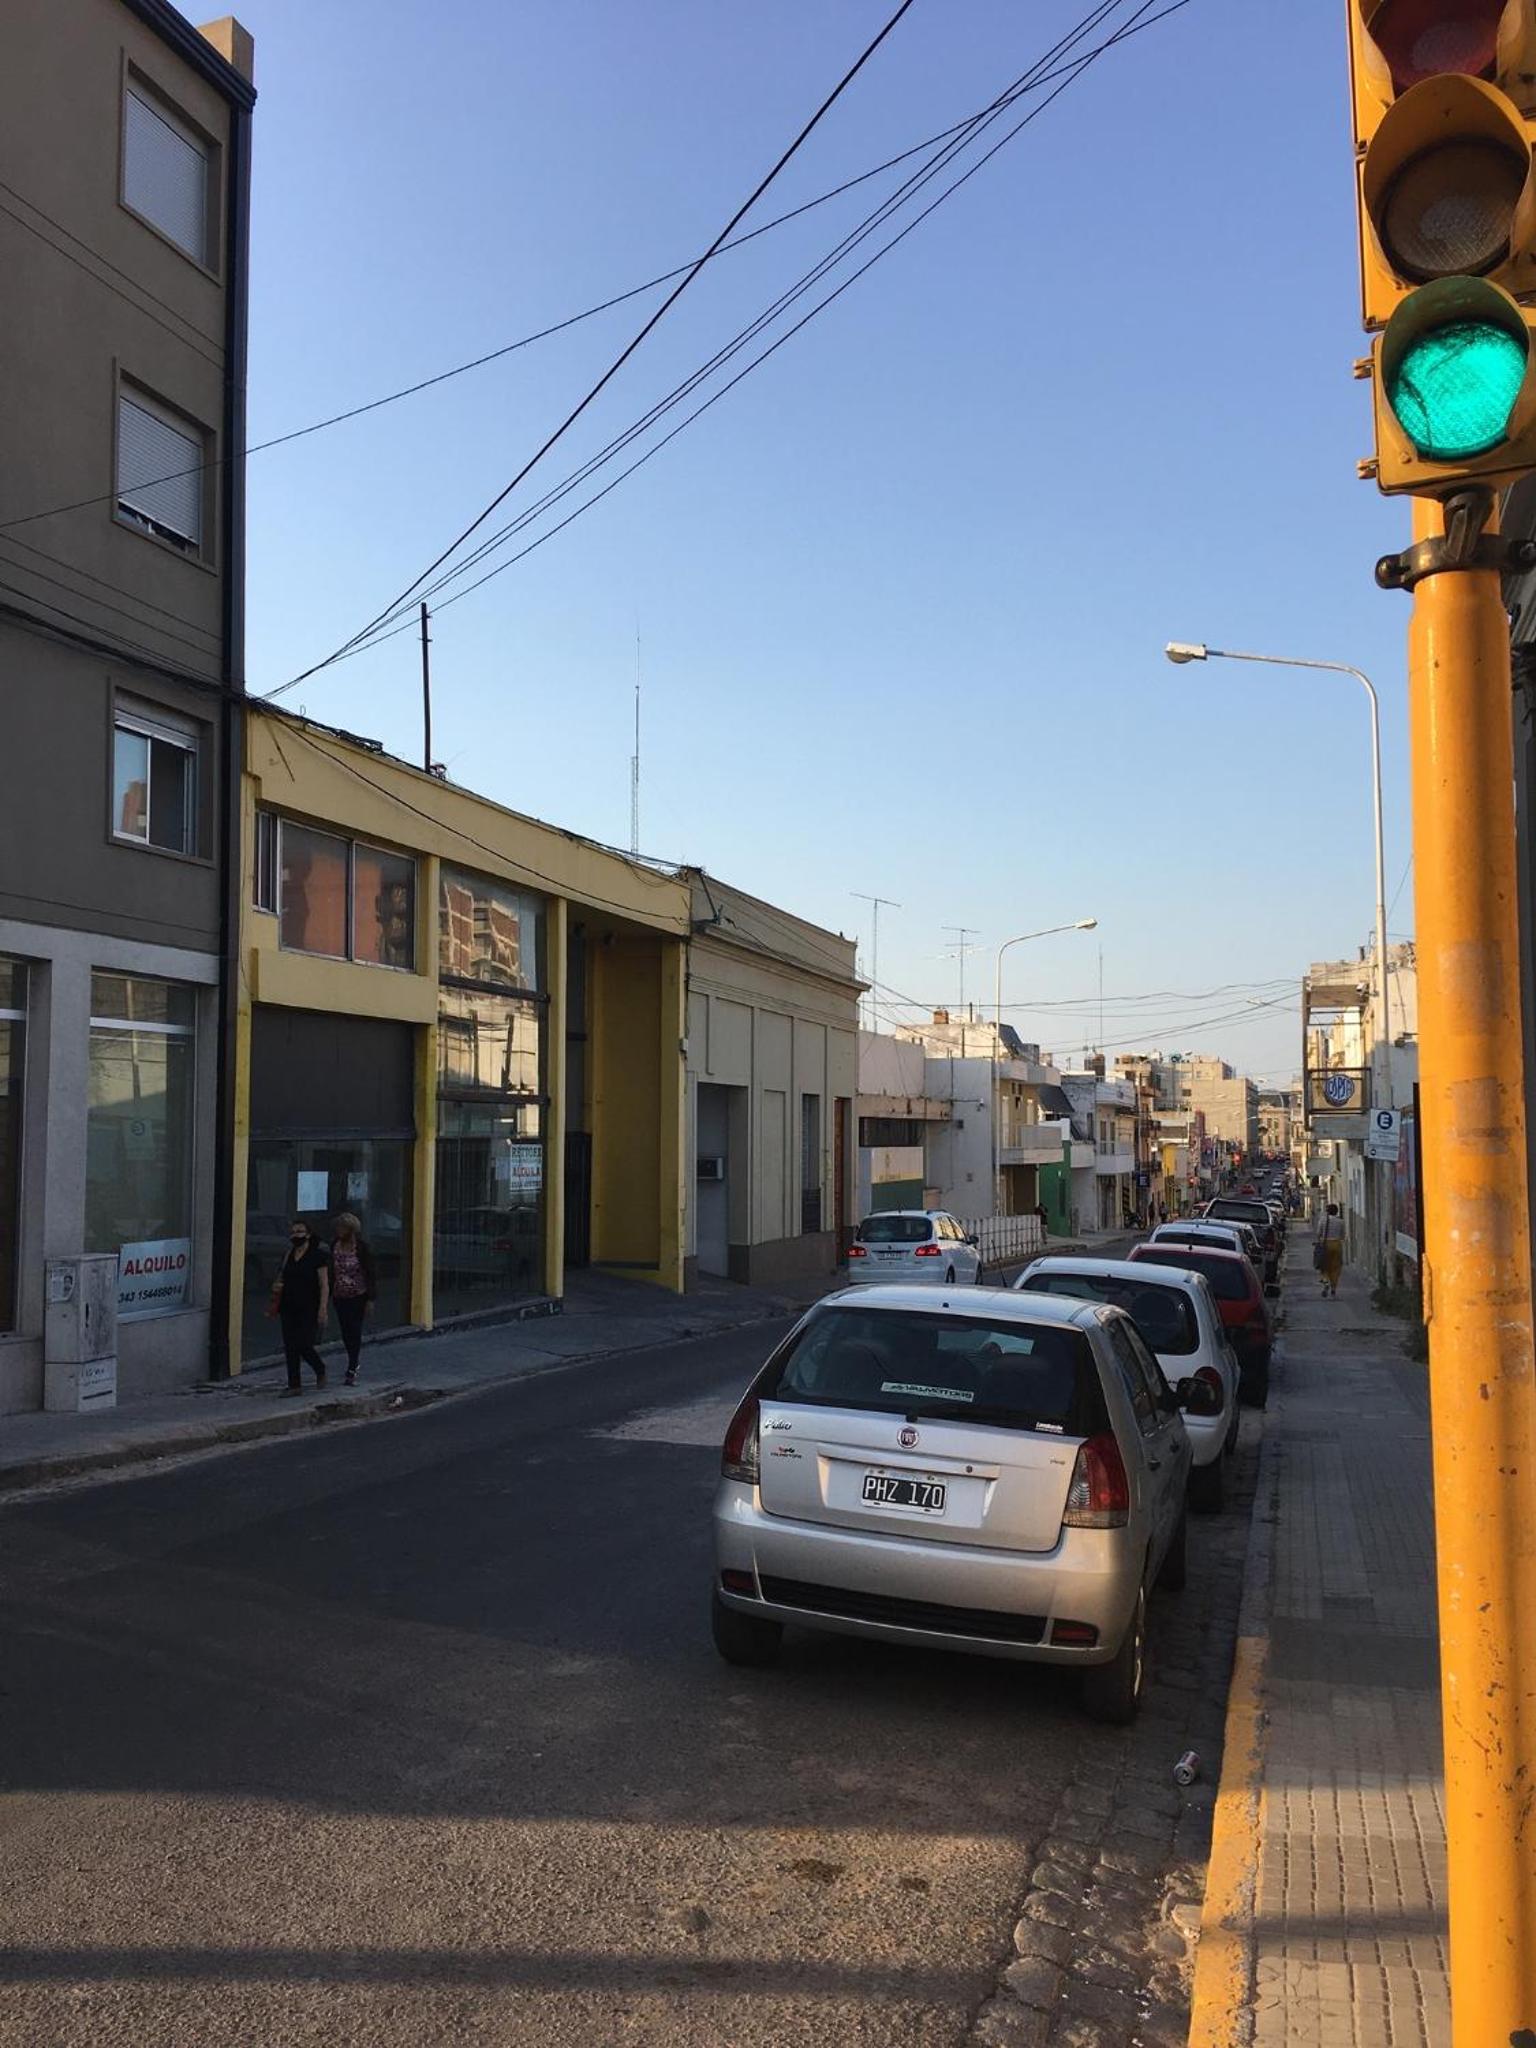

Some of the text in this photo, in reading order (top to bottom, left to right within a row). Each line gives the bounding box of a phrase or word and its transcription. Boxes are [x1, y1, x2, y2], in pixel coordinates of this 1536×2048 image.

[124, 1254, 186, 1276] ALQUILO
[864, 1477, 944, 1508] PHZ 170
